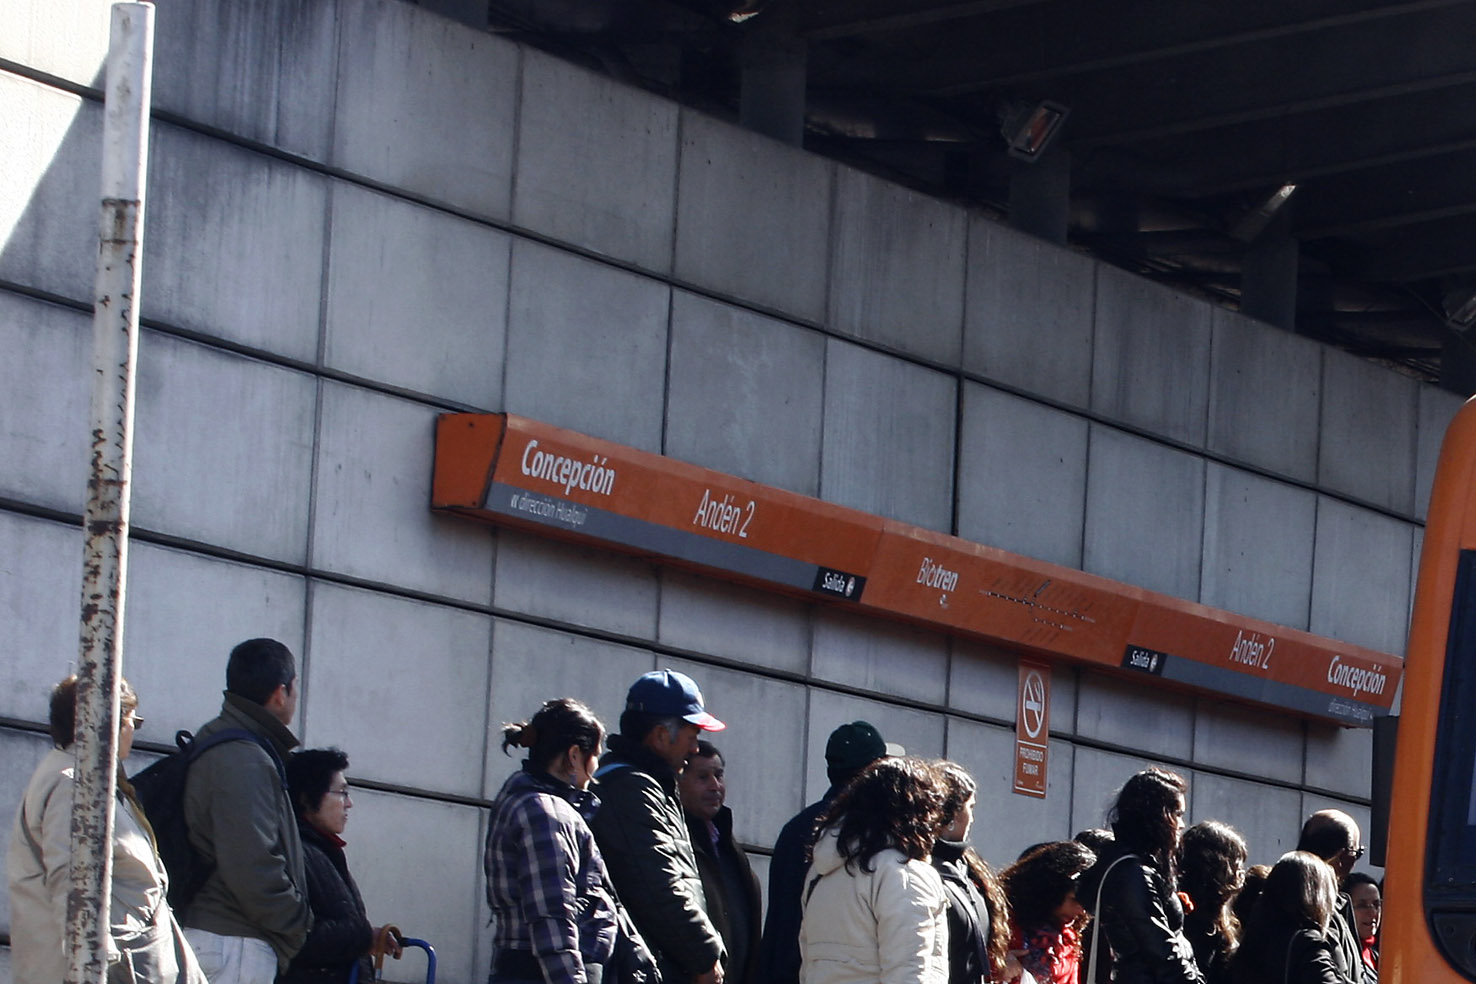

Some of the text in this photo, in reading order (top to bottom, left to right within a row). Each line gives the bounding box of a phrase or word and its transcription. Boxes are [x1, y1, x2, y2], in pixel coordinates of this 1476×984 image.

[521, 439, 616, 496] Concepción
[693, 489, 756, 539] Andén 2
[822, 571, 846, 594] Salida
[916, 556, 959, 593] Biotren
[1130, 649, 1150, 669] Salida
[1229, 629, 1276, 670] Andén 2
[1327, 655, 1387, 697] Concepción
